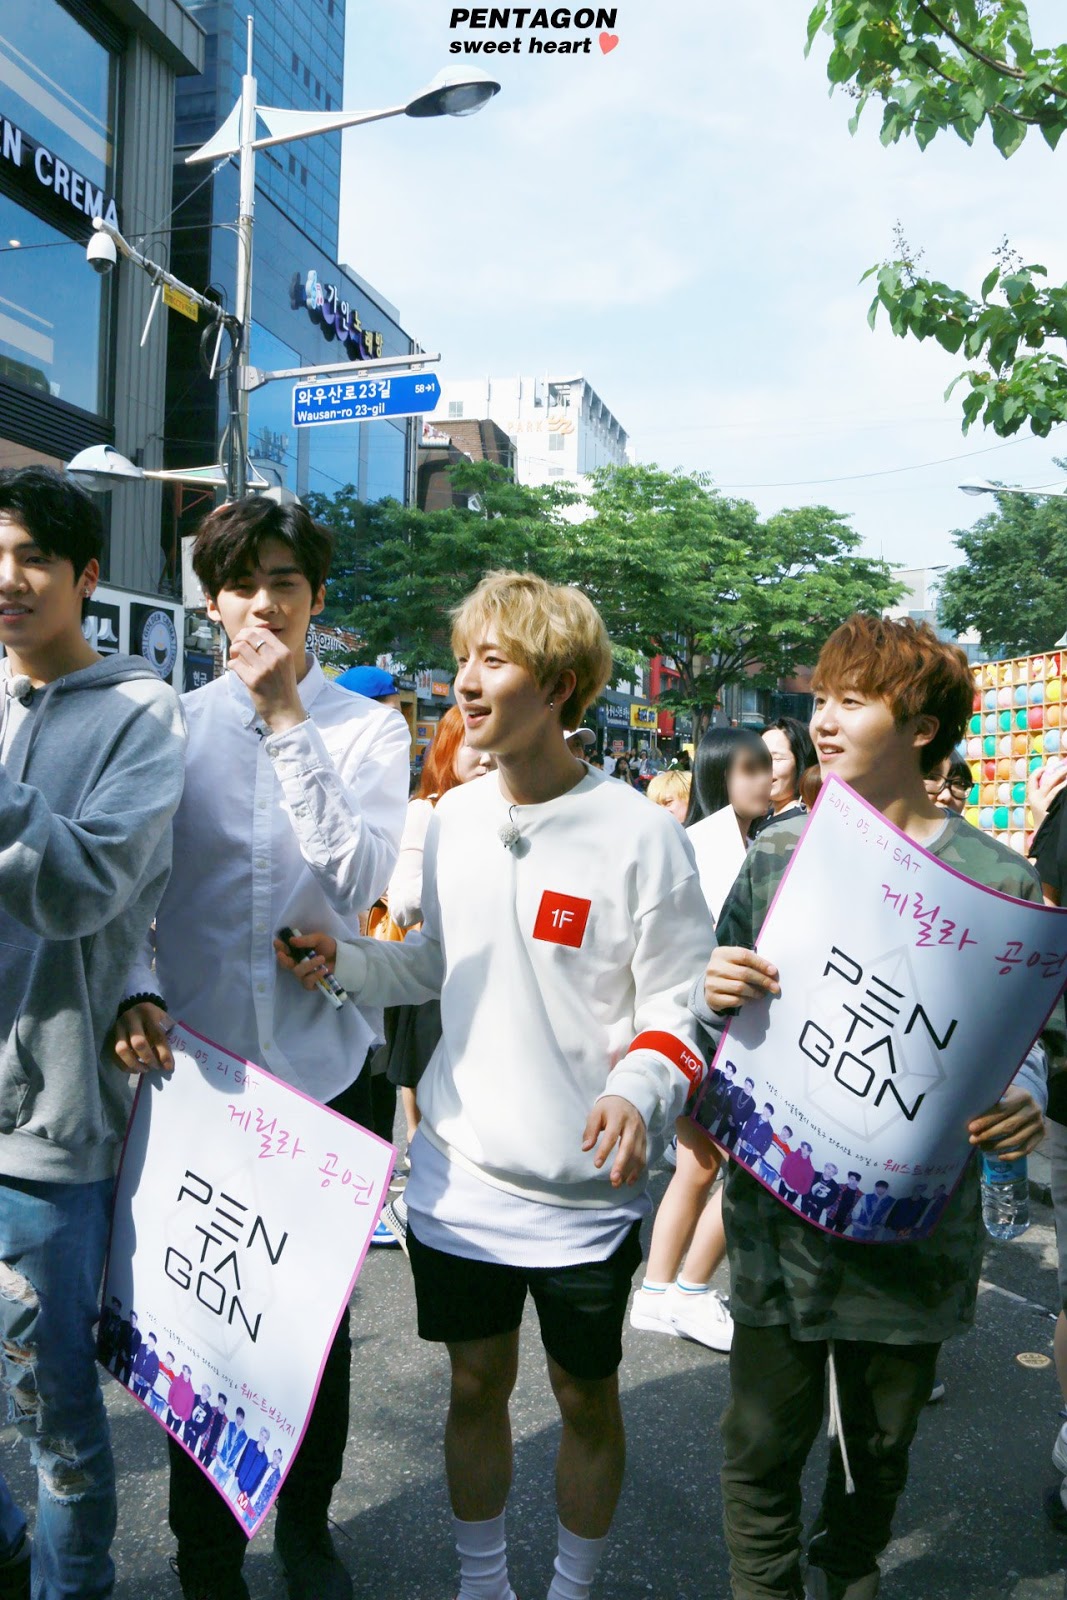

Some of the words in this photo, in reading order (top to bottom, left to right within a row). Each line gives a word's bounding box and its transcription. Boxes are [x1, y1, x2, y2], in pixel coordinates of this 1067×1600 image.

[0, 115, 22, 168] N
[34, 146, 119, 232] CREMA
[297, 407, 353, 422] Wausan-ro
[355, 402, 386, 417] 23-gil
[893, 847, 922, 873] SAT
[551, 908, 575, 929] 1F
[881, 883, 978, 951] 게릴라
[994, 941, 1067, 979] 공연
[227, 1104, 306, 1160] 게릴라
[318, 1152, 374, 1206] 공연
